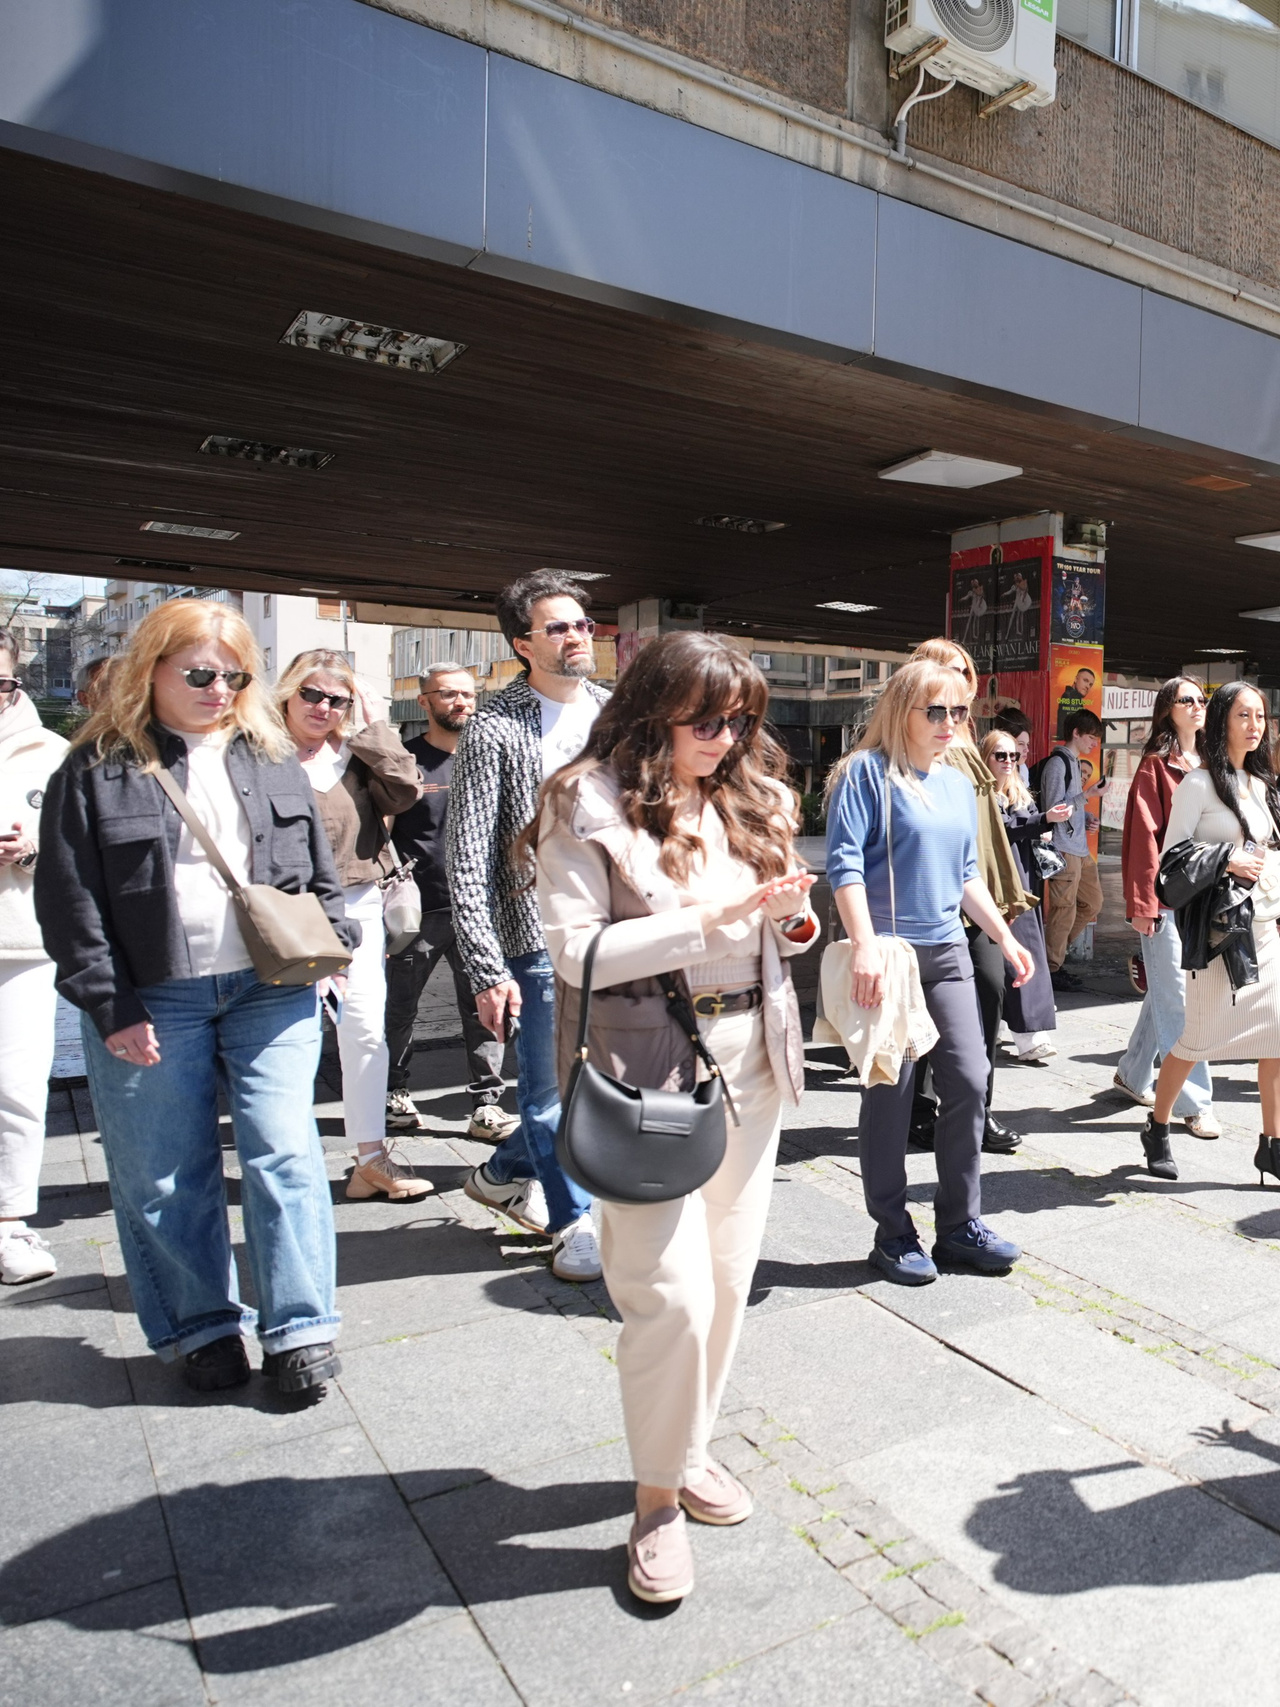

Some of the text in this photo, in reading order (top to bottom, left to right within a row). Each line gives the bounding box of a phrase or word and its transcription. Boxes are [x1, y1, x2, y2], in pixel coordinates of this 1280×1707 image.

[1087, 567, 1101, 575] TOUR
[1107, 690, 1155, 710] NIJE FILO
